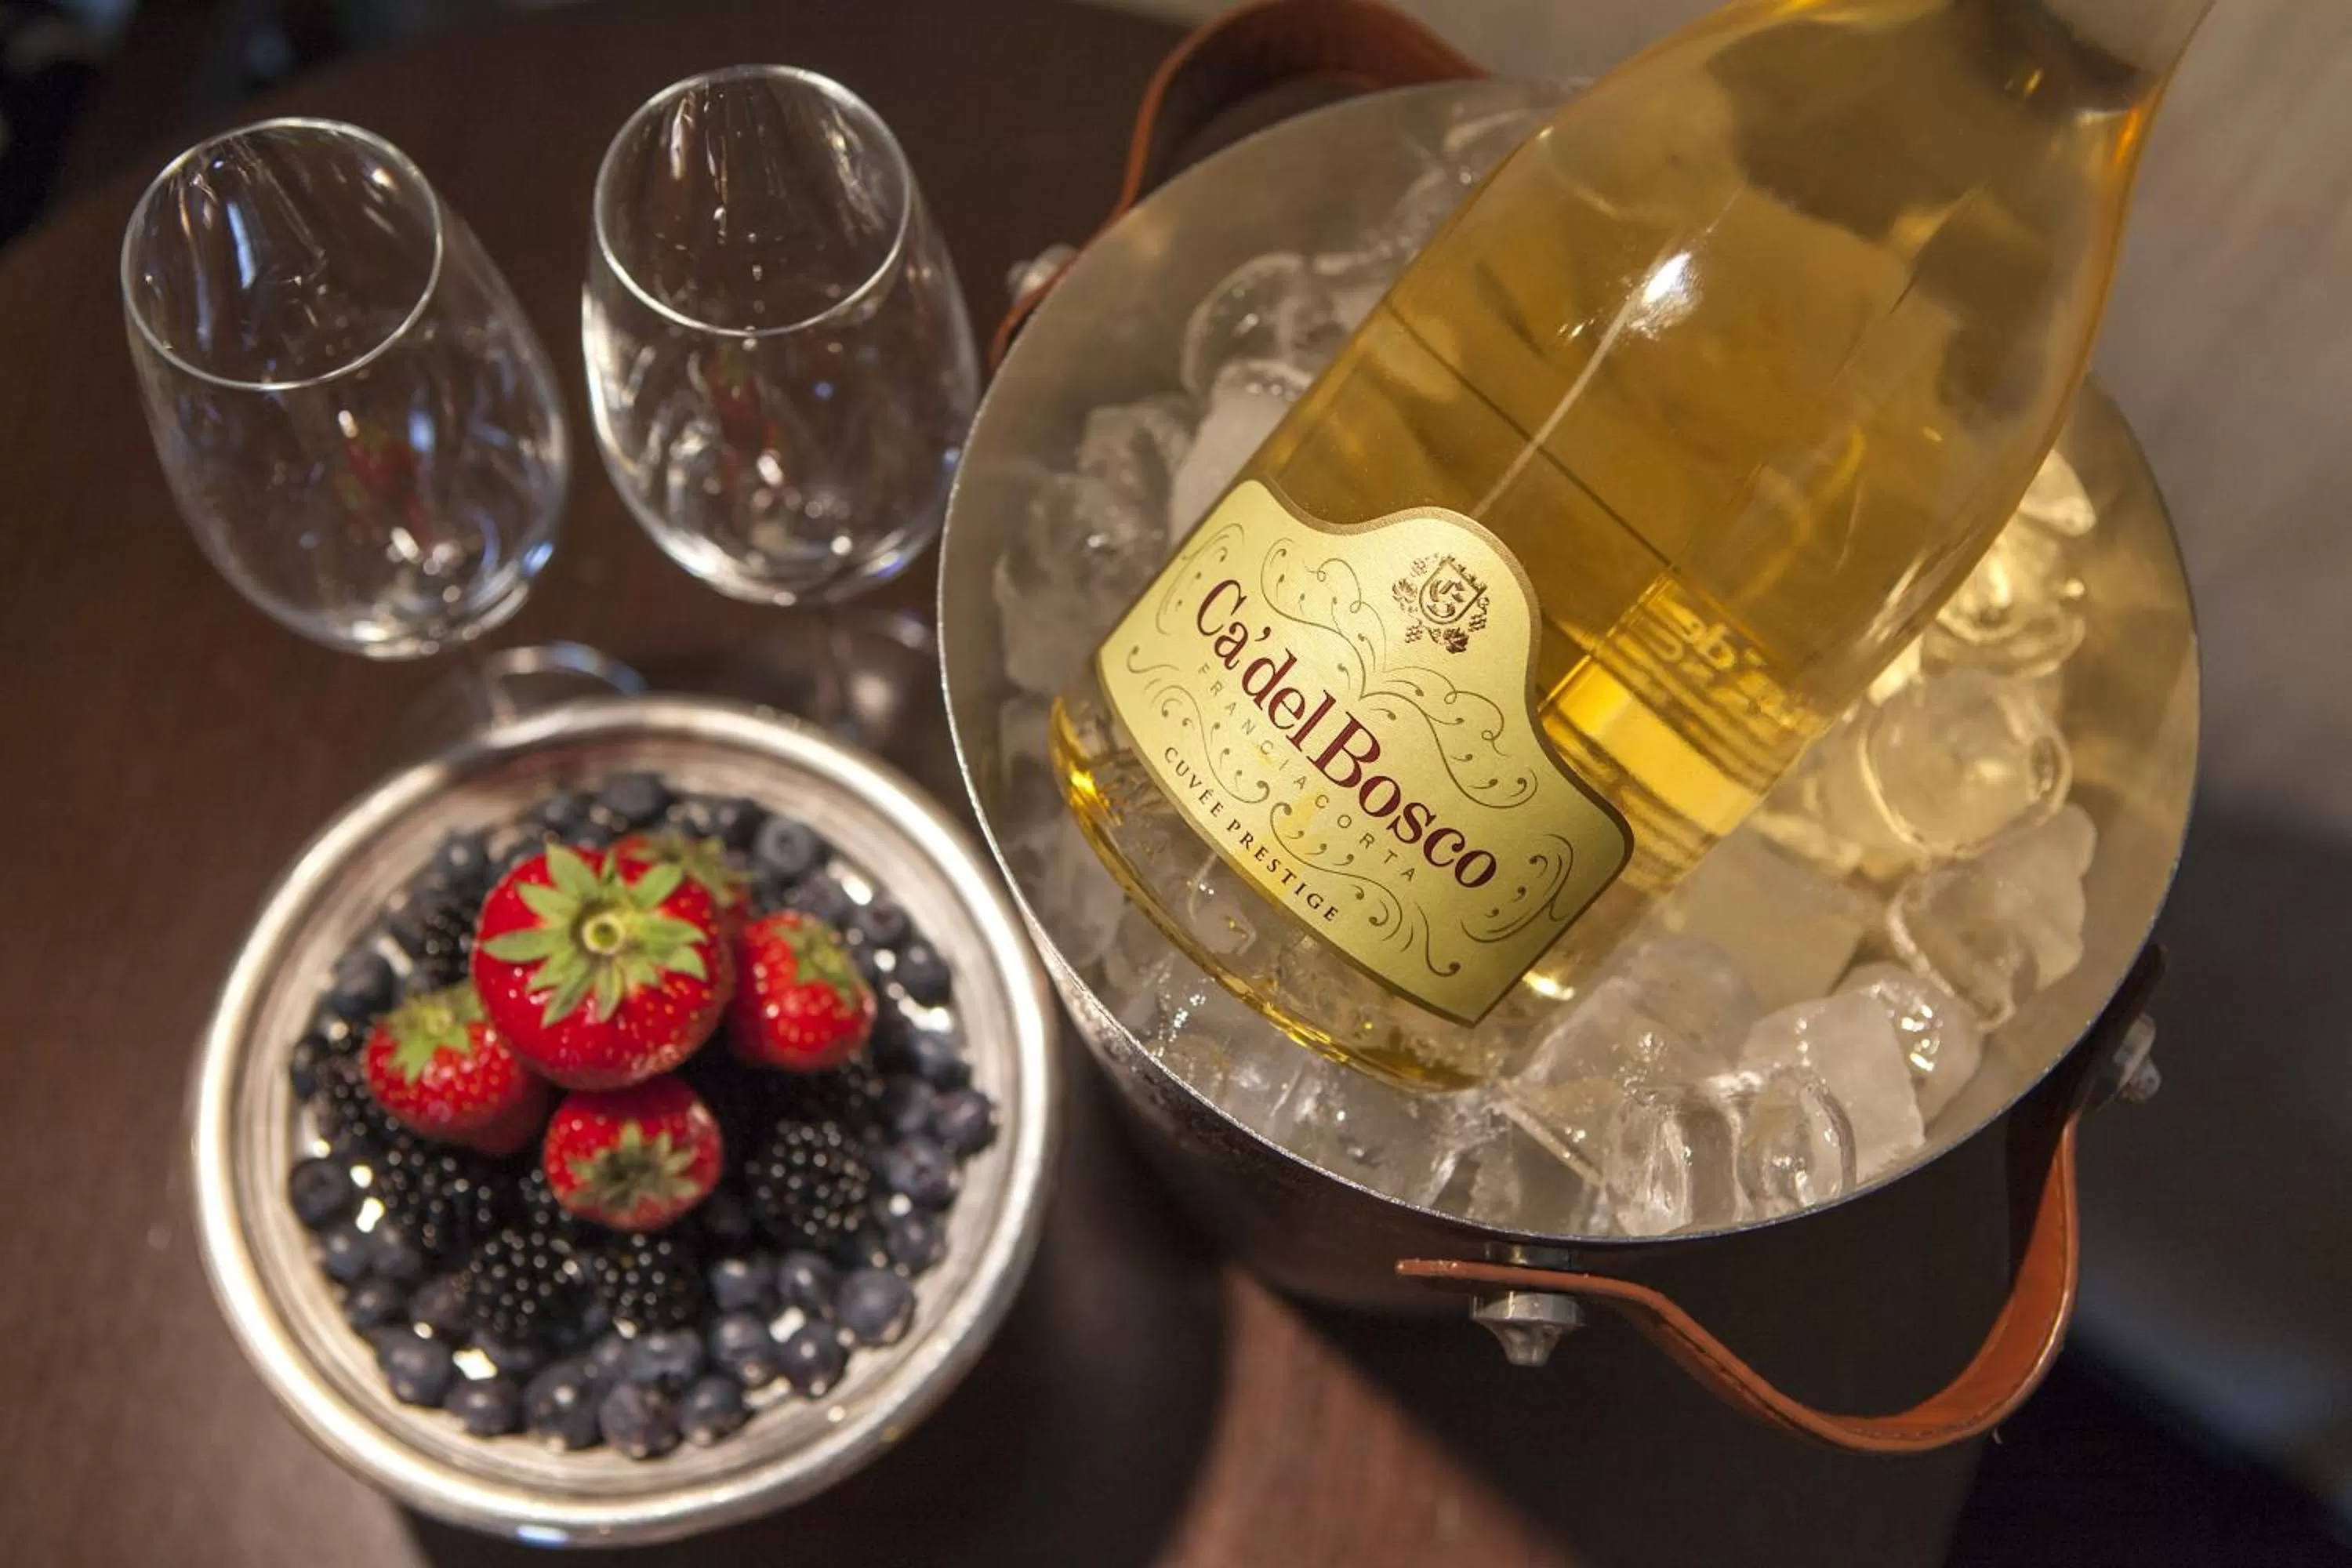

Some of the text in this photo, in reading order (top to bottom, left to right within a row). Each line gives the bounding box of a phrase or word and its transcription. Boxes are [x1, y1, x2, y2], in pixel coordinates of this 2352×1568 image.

[1165, 747, 1338, 921] CUVÉE PRESTIGE
[1198, 662, 1416, 880] FRANCIACORTA
[1306, 711, 1497, 888] Bosco
